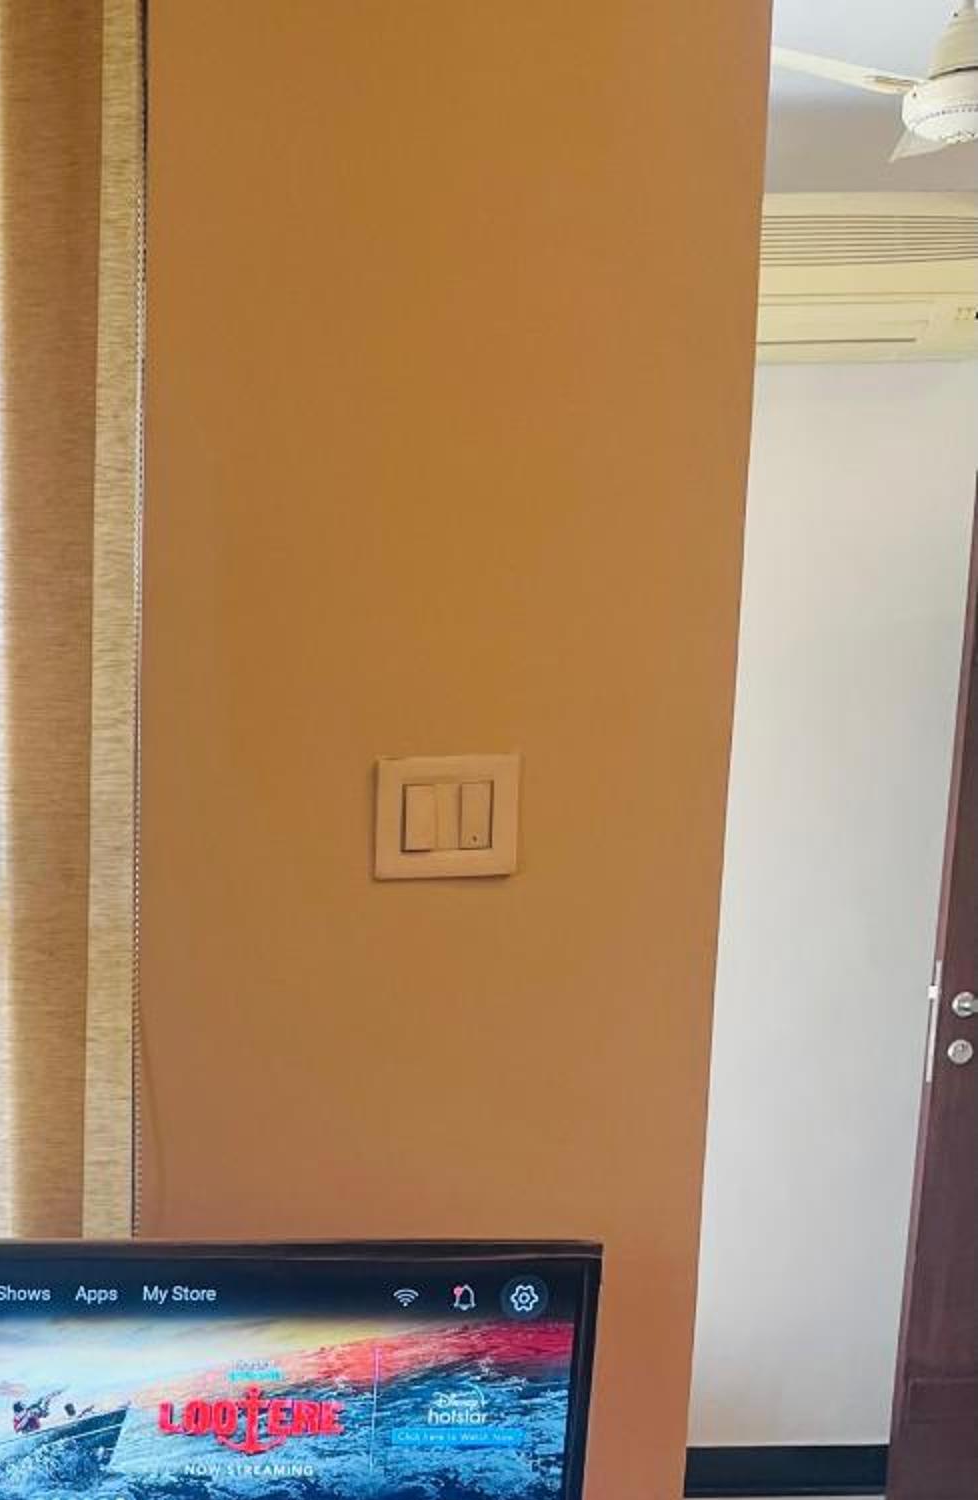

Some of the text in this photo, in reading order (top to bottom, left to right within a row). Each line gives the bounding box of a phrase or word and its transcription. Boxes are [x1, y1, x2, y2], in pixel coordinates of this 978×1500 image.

[75, 1286, 119, 1304] Apps
[142, 1285, 217, 1304] My Store
[157, 1386, 346, 1454] LOOTERE
[427, 1408, 487, 1424] hotstar
[184, 1464, 314, 1477] NOW STREAMING
